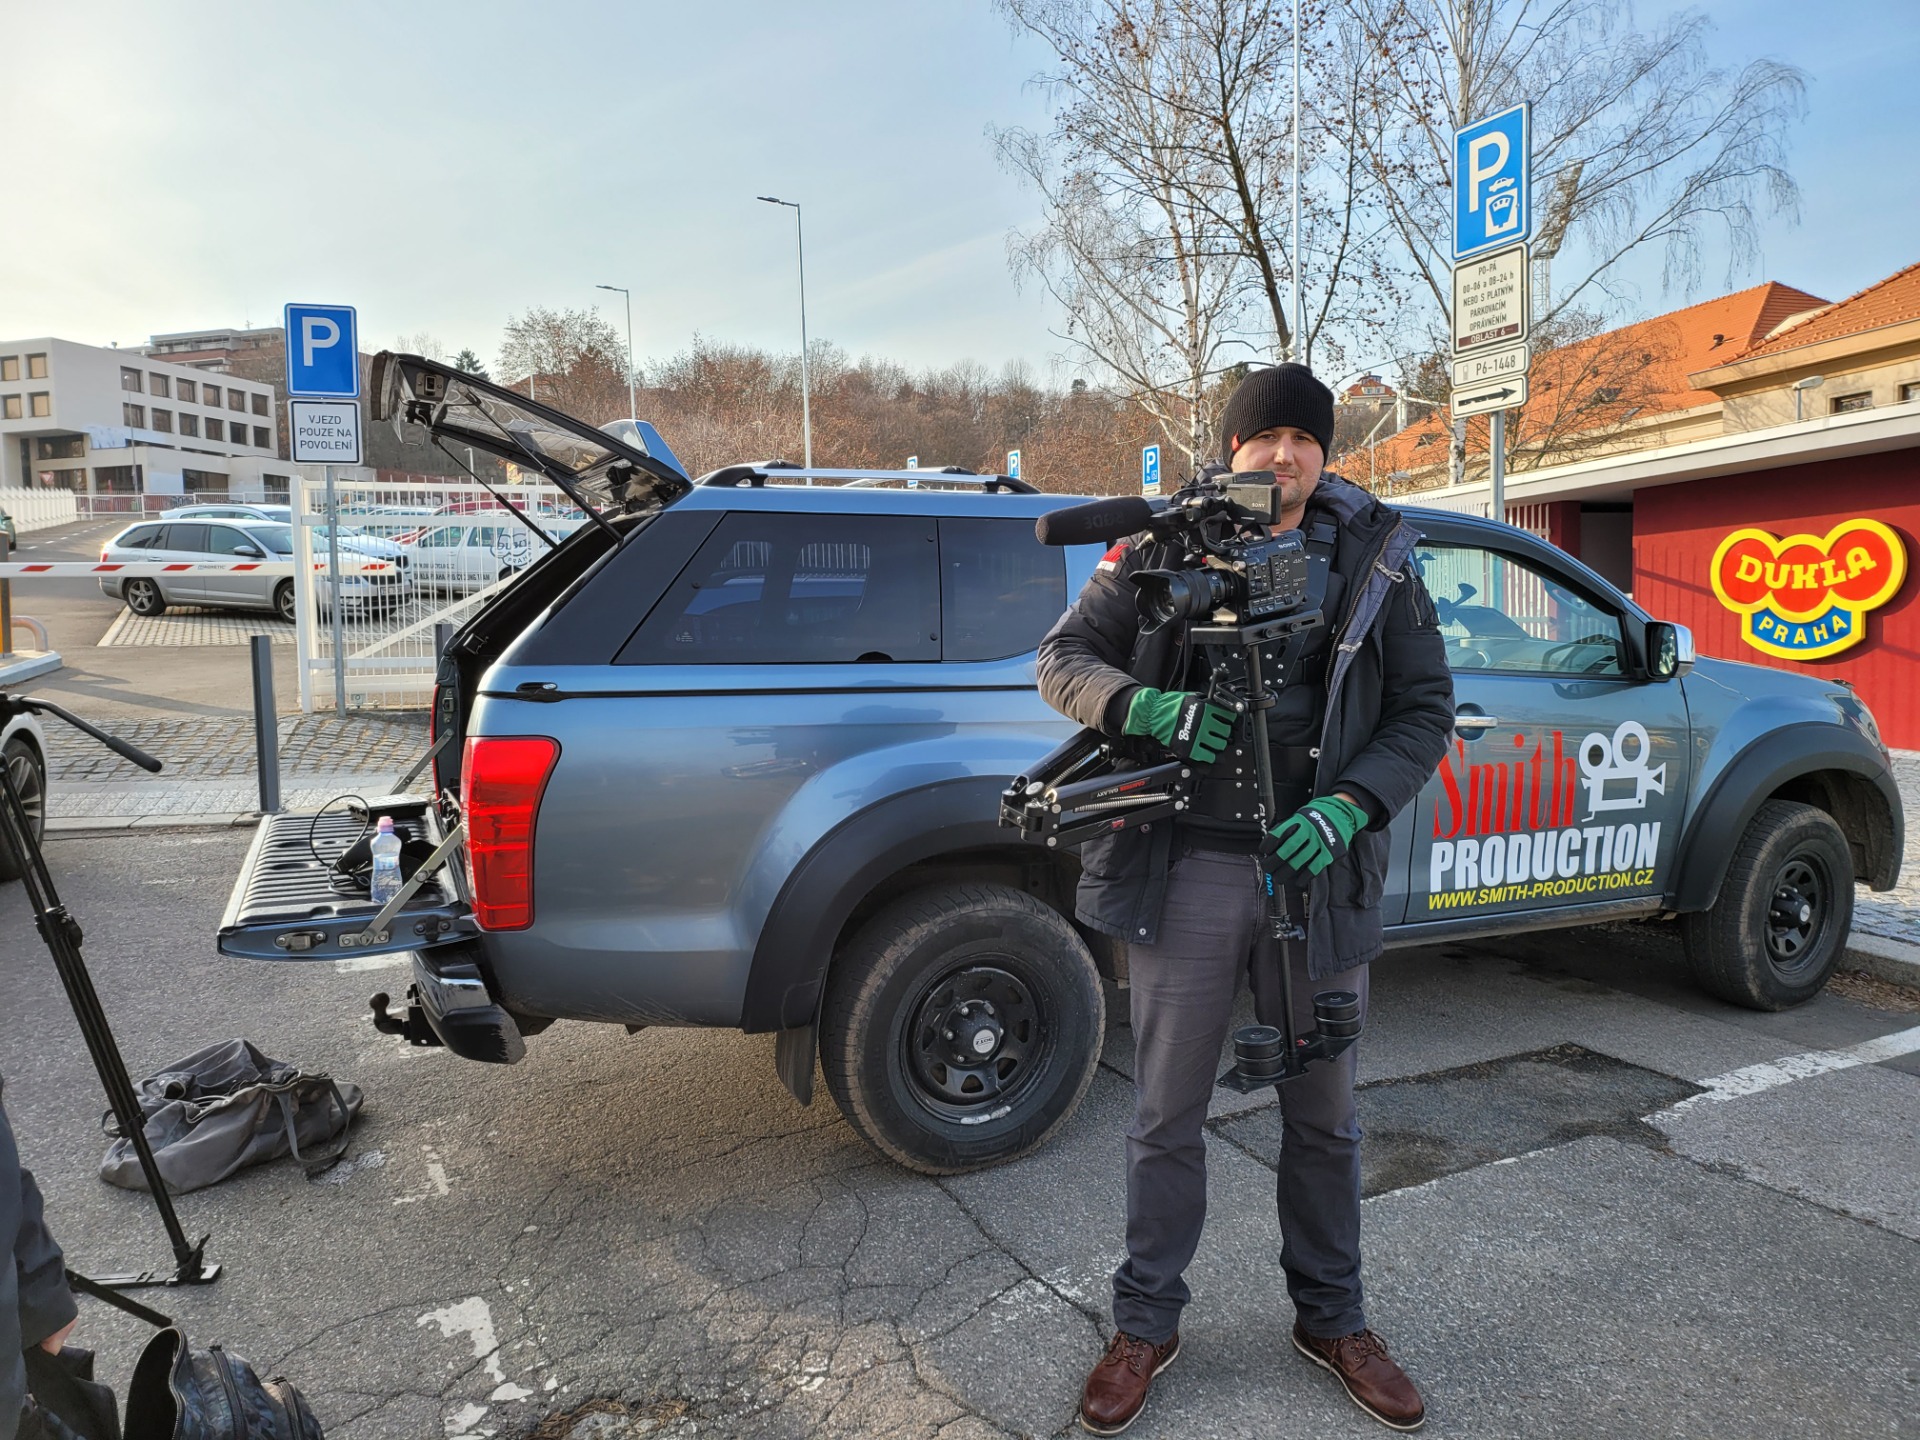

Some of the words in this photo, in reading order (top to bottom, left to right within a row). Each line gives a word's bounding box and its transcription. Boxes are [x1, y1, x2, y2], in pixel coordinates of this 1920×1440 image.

[1468, 131, 1510, 213] P
[1478, 260, 1497, 276] PO-PÁ
[1463, 281, 1481, 294] 00-06
[1489, 272, 1507, 286] 08-24
[1509, 271, 1514, 279] h
[1463, 295, 1478, 307] NEBO
[1480, 293, 1485, 302] S
[1487, 284, 1514, 300] PLATNÝM
[1470, 299, 1506, 318] PARKOVACÍM
[1469, 312, 1507, 331] OPRÁVNĚNÍM
[302, 316, 341, 367] P
[1470, 329, 1499, 344] OBLAST
[1500, 327, 1506, 336] 6
[1476, 354, 1516, 376] P6-1448
[308, 414, 342, 425] VJEZD
[299, 427, 334, 437] POUZE
[337, 428, 352, 438] NA
[300, 439, 352, 450] POVOLENÍ
[1146, 451, 1156, 474] P
[1278, 542, 1297, 550] SONY
[1735, 546, 1877, 590] DUKLA
[1758, 615, 1848, 645] PRAHA
[1433, 731, 1577, 839] Smith
[1430, 821, 1662, 893] PRODUCTION
[1428, 869, 1655, 910] WWW.SMITH-PRODUCTION.CZ
